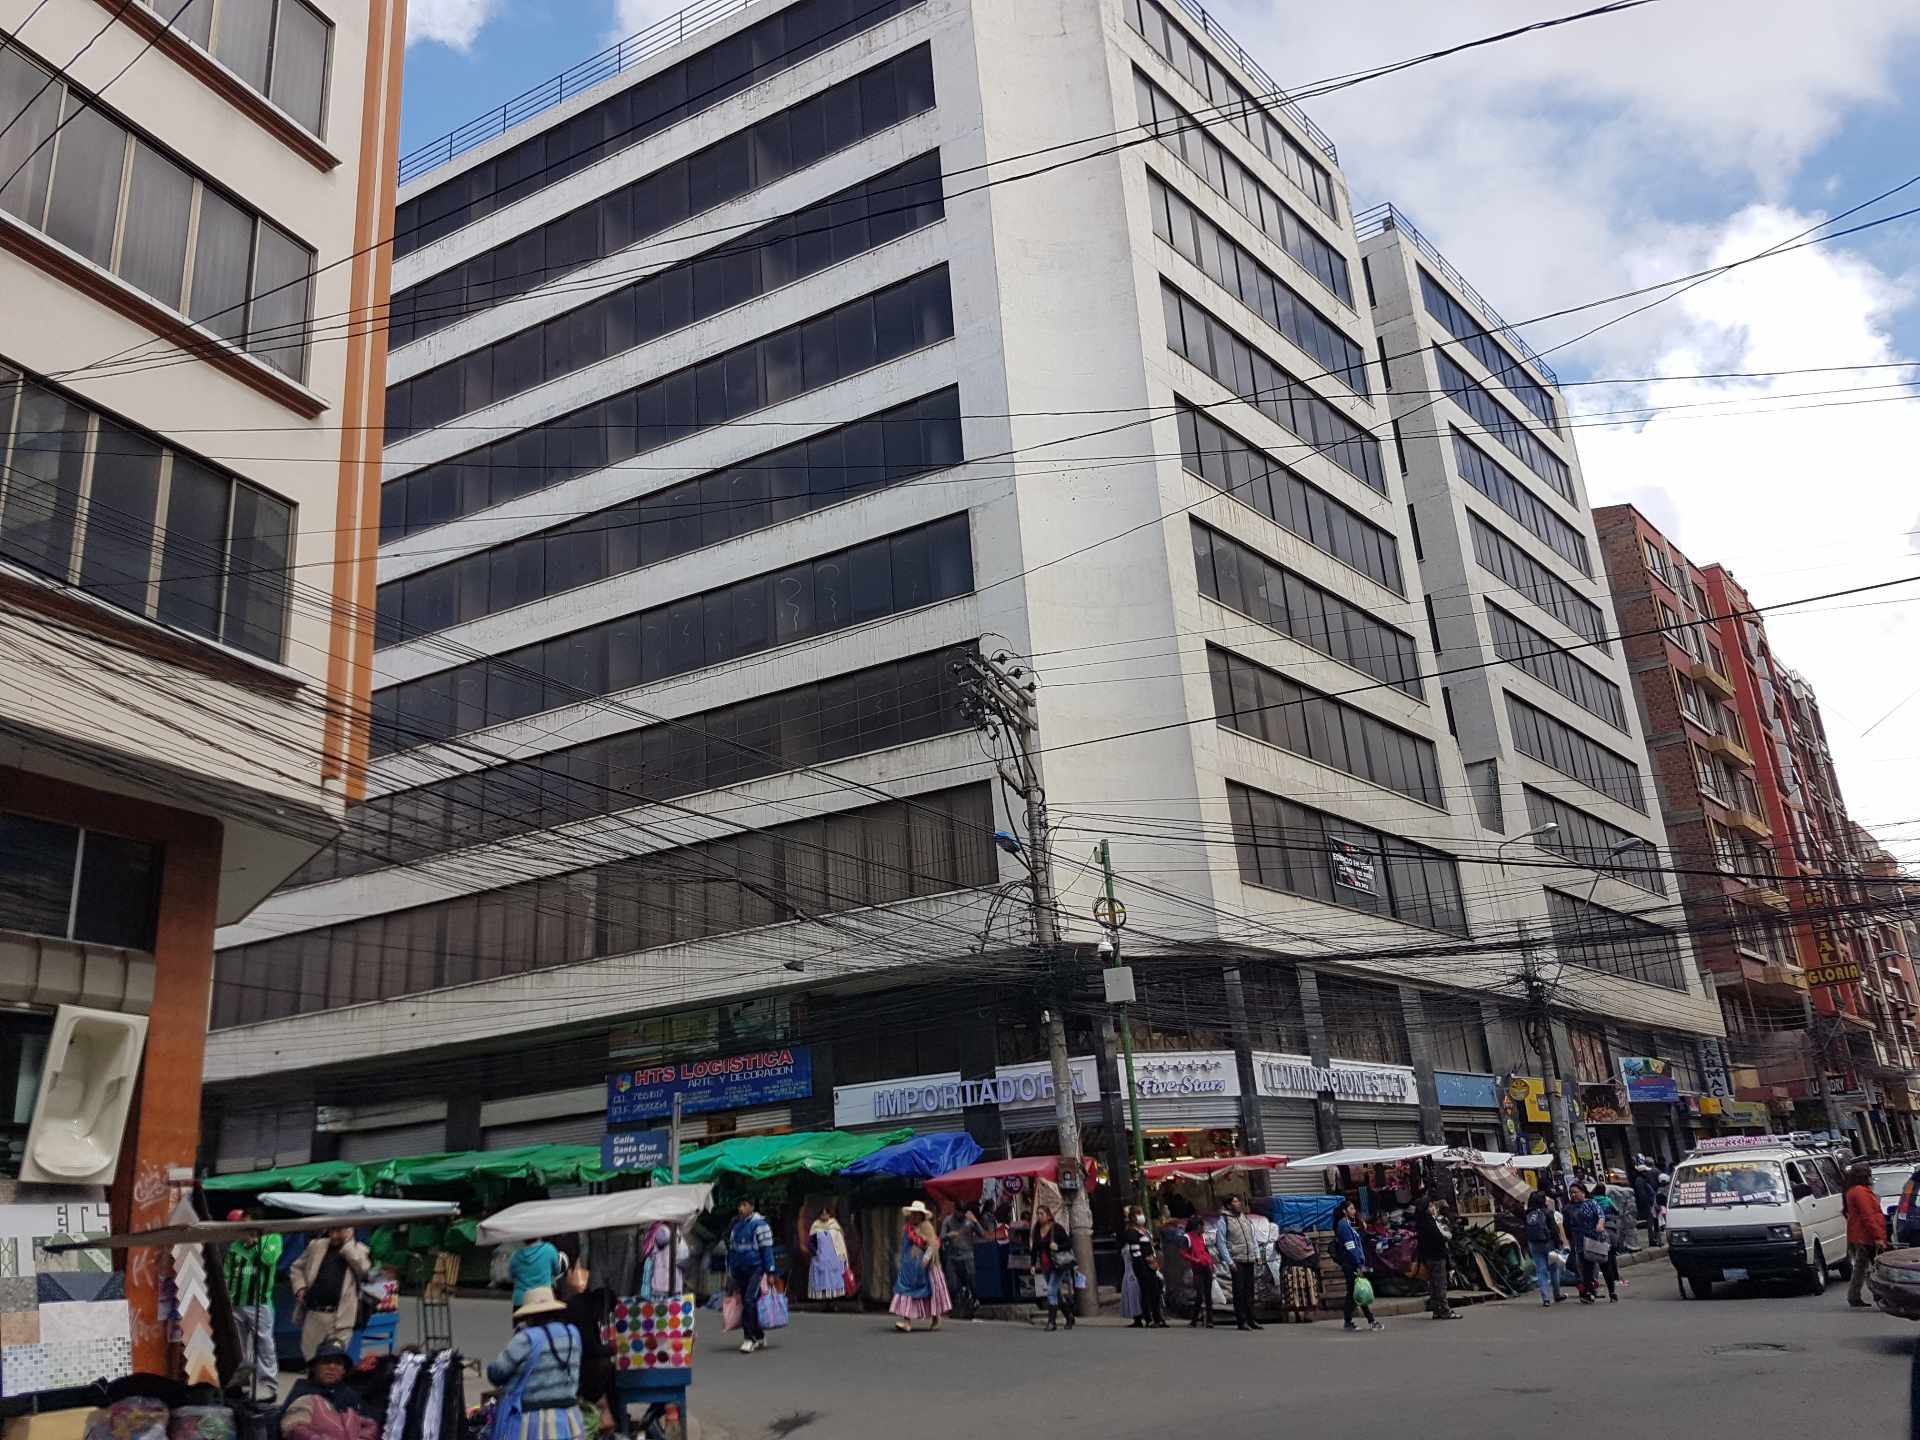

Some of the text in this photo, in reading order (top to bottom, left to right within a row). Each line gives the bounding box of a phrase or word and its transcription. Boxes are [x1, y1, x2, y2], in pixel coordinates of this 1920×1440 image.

[1808, 964, 1858, 985] GLORIA
[634, 1048, 795, 1087] HTS LOGISTICA
[613, 1135, 635, 1145] Calle
[613, 1145, 637, 1154] Santa
